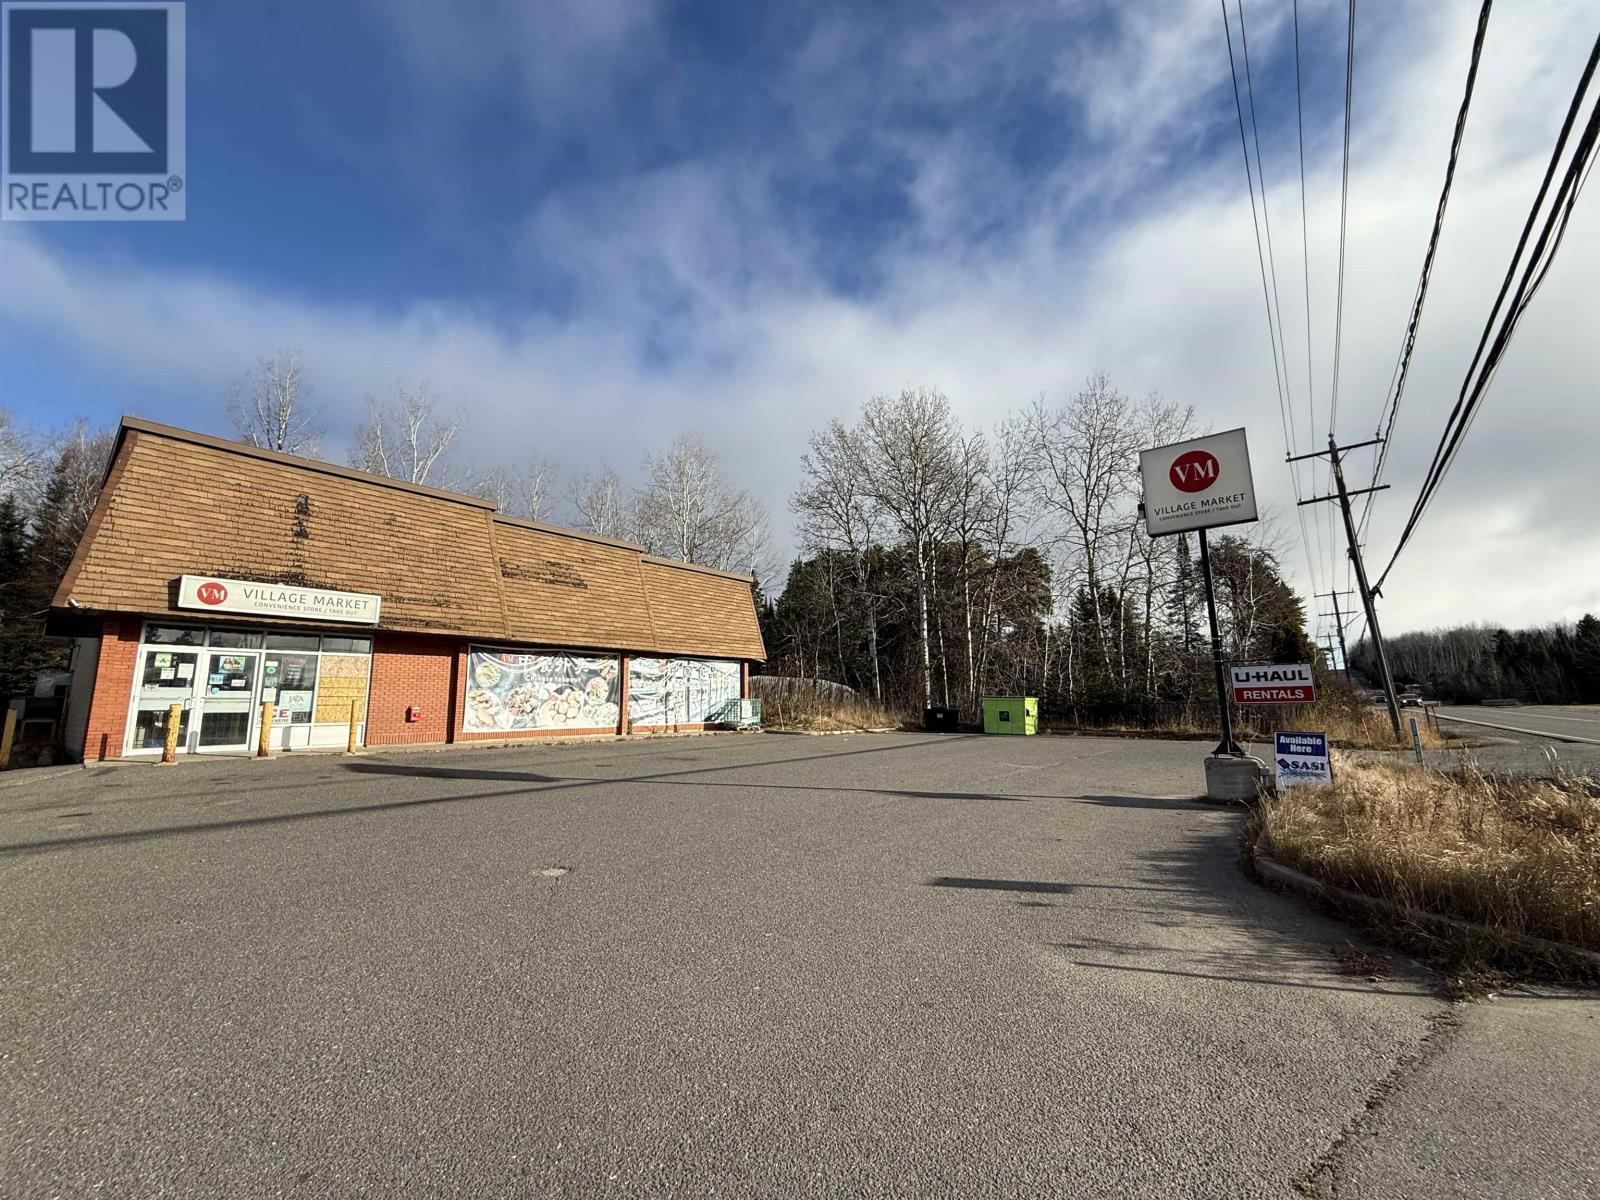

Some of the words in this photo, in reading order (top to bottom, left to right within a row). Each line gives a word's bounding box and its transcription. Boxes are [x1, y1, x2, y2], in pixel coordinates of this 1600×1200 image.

[1173, 458, 1216, 483] VM
[1154, 501, 1197, 516] VILLAGE
[1201, 493, 1246, 508] MARKET
[1159, 512, 1193, 521] CONVENIENCE
[200, 587, 226, 601] VM
[243, 588, 307, 605] VILLAGE
[313, 595, 369, 610] MARKET
[254, 602, 301, 611] CONVENIENCE
[525, 674, 553, 682] Chinese
[1234, 669, 1309, 683] U-HAUL
[1243, 689, 1305, 700] RENTALS
[1280, 736, 1322, 745] Available
[1290, 744, 1312, 753] Here
[1291, 761, 1326, 770] SASI
